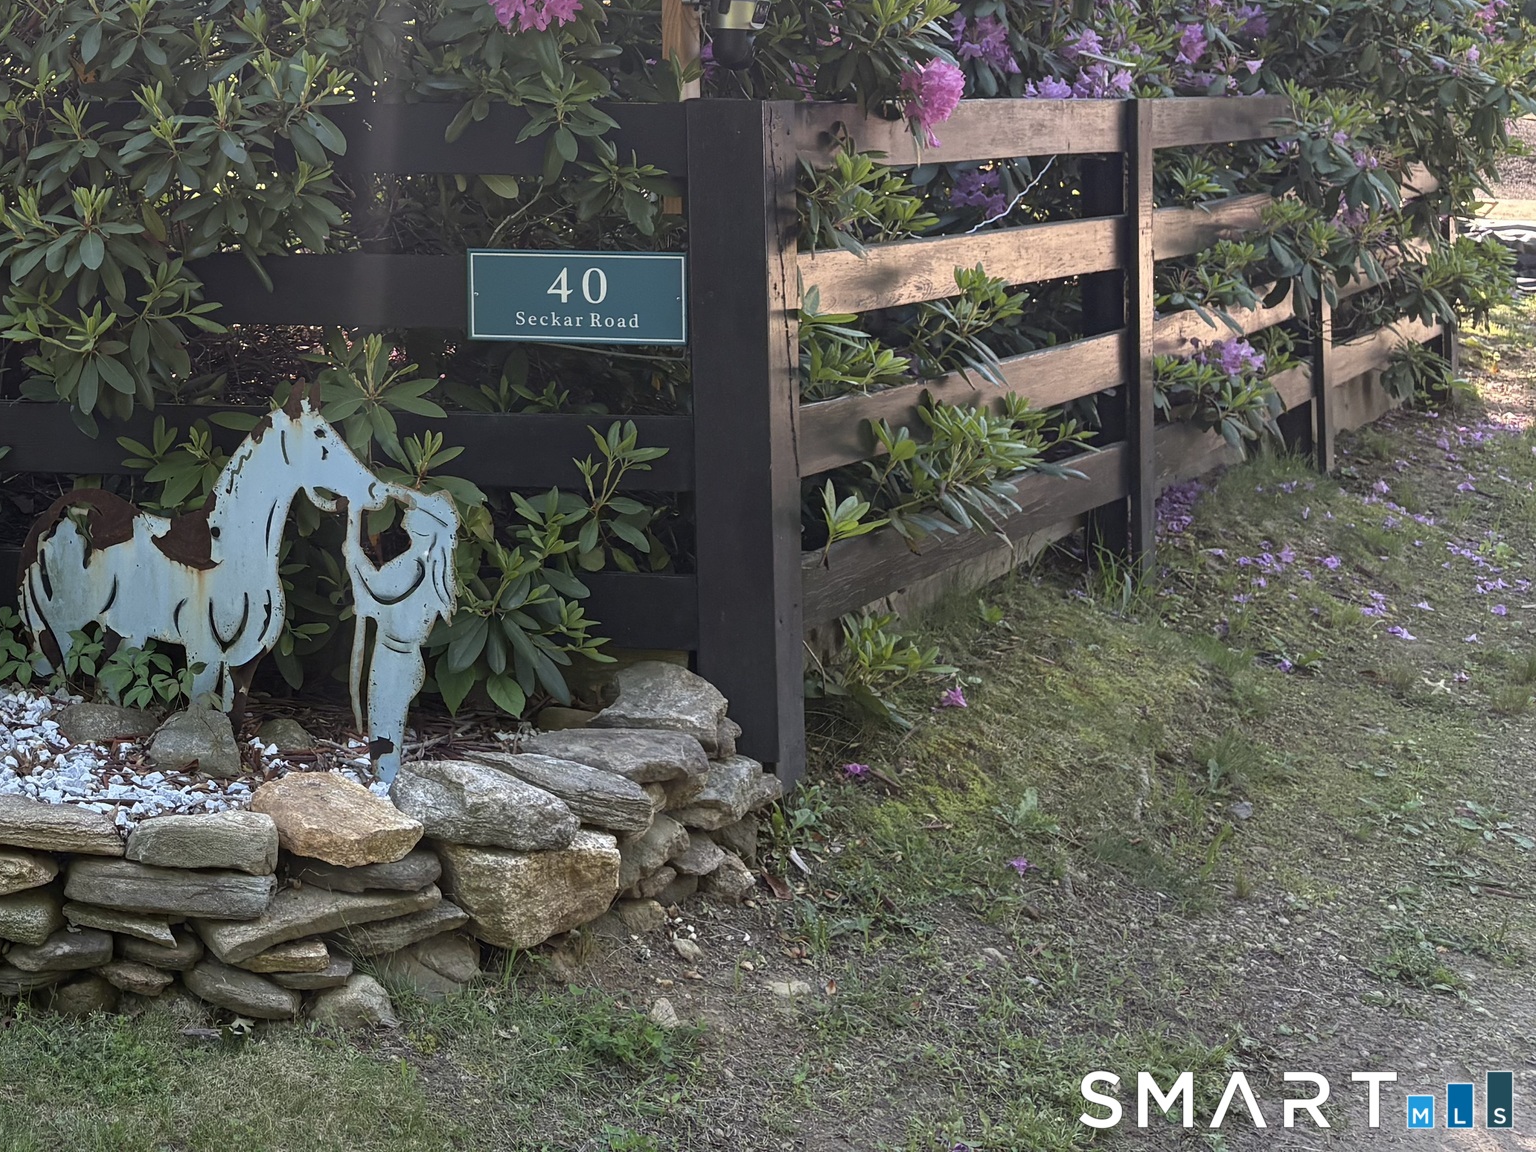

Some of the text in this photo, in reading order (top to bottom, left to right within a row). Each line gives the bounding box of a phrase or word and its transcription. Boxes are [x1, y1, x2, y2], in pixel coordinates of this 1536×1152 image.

[546, 266, 608, 304] 40
[515, 310, 640, 329] Seckar Road
